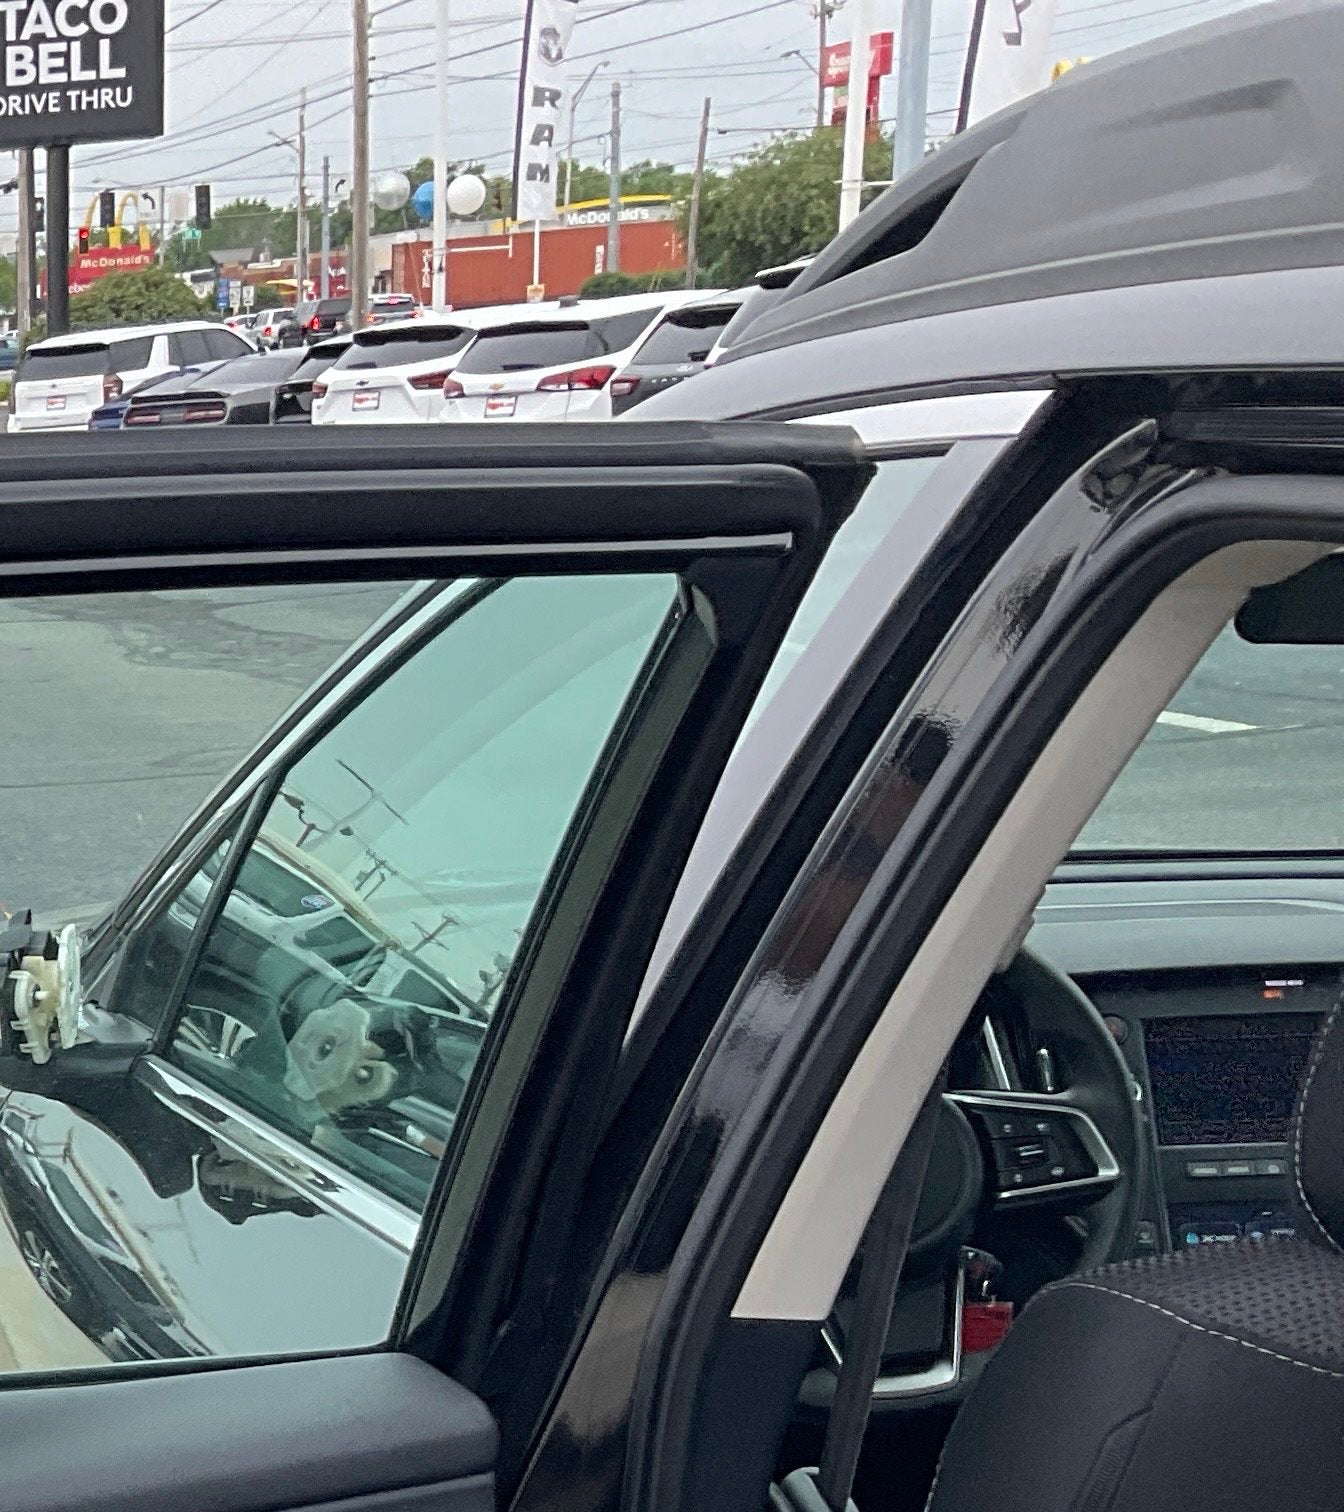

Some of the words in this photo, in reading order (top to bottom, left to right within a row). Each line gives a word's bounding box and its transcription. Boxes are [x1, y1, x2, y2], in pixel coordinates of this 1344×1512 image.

[5, 38, 126, 87] BELL
[66, 85, 133, 111] THRU
[526, 85, 562, 184] RAM
[80, 254, 150, 269] McDonald's
